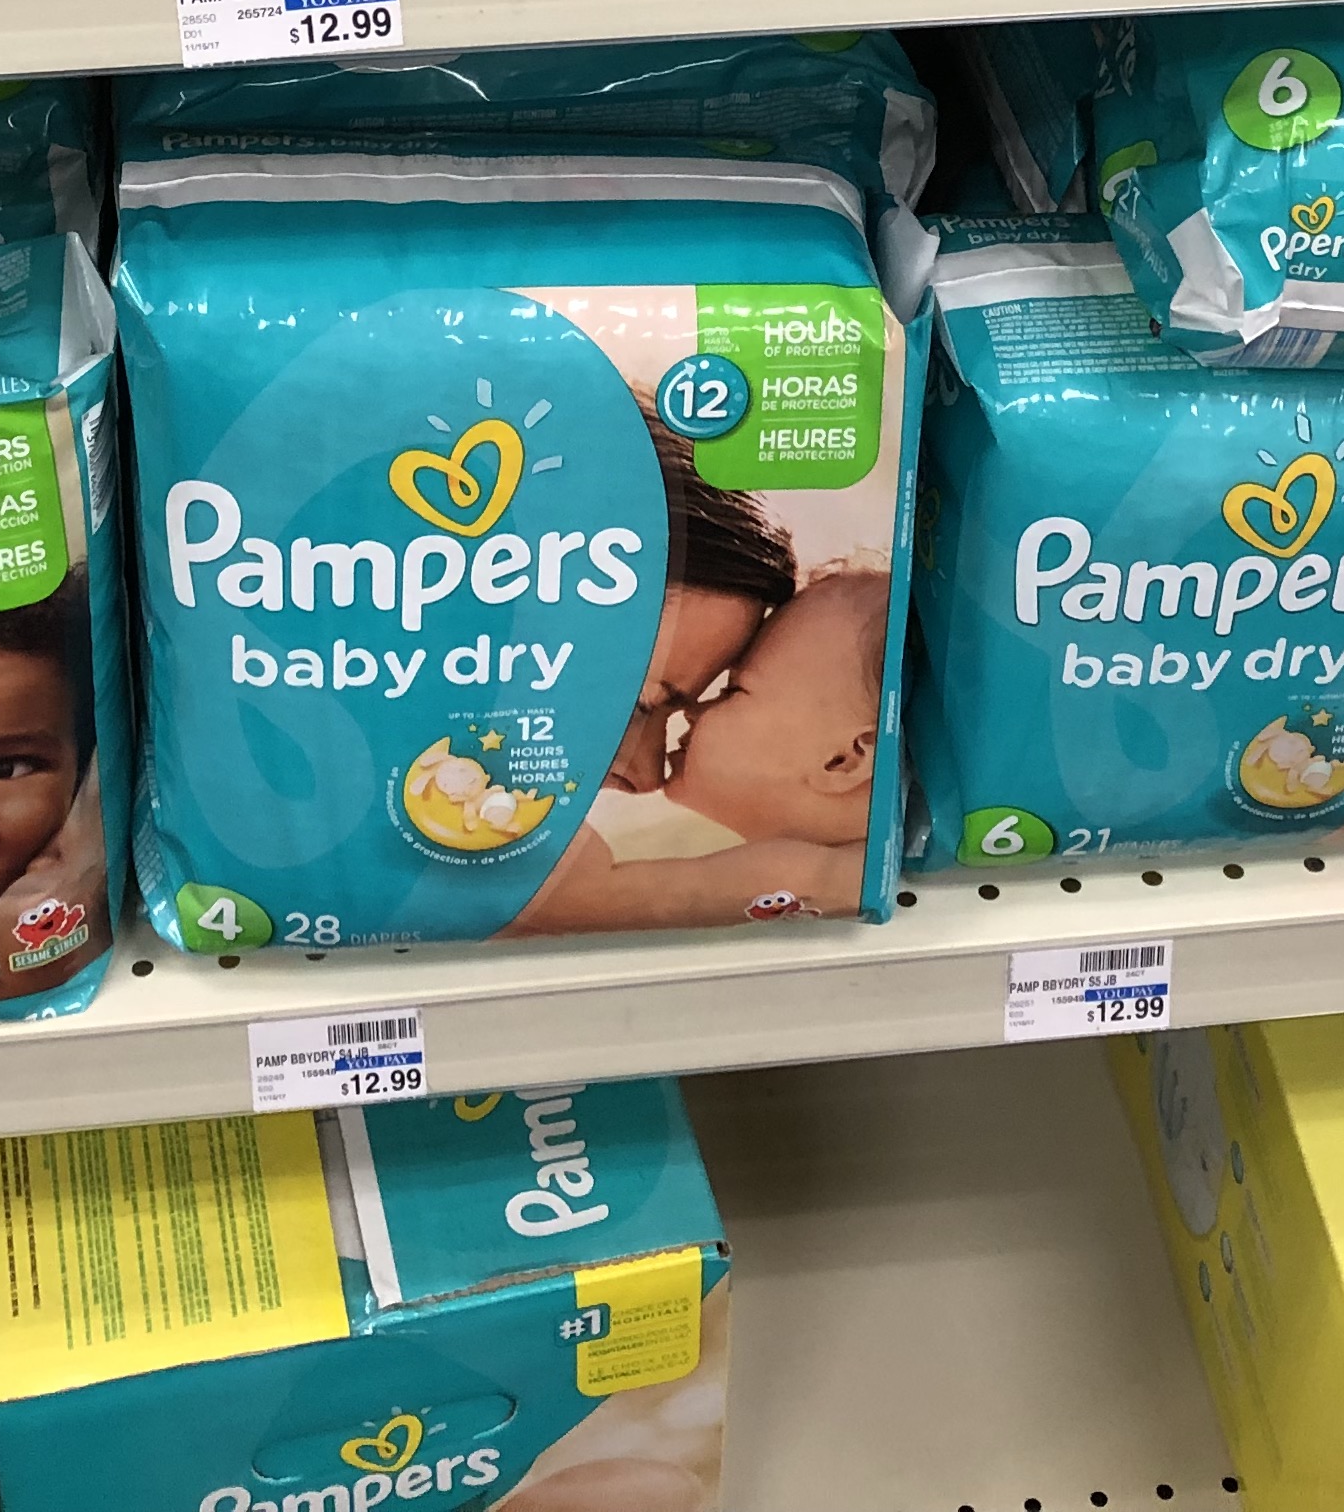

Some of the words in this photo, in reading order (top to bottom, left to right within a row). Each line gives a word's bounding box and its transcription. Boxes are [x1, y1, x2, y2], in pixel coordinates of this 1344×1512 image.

[237, 6, 282, 20] 265724
[290, 7, 392, 46] $12.99
[1257, 57, 1310, 117] 6
[762, 318, 863, 348] HOURS
[676, 377, 730, 420] 12
[761, 372, 859, 399] HORAS
[758, 427, 858, 452] HEURES
[165, 479, 643, 633] Pampers
[231, 633, 426, 699] baby
[442, 633, 575, 693] dry
[1061, 641, 1232, 691] baby
[517, 716, 554, 742] 12
[508, 758, 569, 771] HEURES
[510, 745, 565, 757] HOURS
[512, 771, 565, 784] HORAS
[981, 813, 1027, 856] 6
[1066, 826, 1112, 858] 21
[196, 896, 244, 942] 4
[284, 912, 342, 947] 28
[1009, 981, 1039, 994] PAMP
[1043, 977, 1085, 991] BBYDRY
[1087, 997, 1165, 1022] $12.99
[256, 1054, 287, 1068] PAMP
[291, 1050, 336, 1065] BBYDRY
[341, 1068, 422, 1096] $12.99
[560, 1309, 601, 1339] #1
